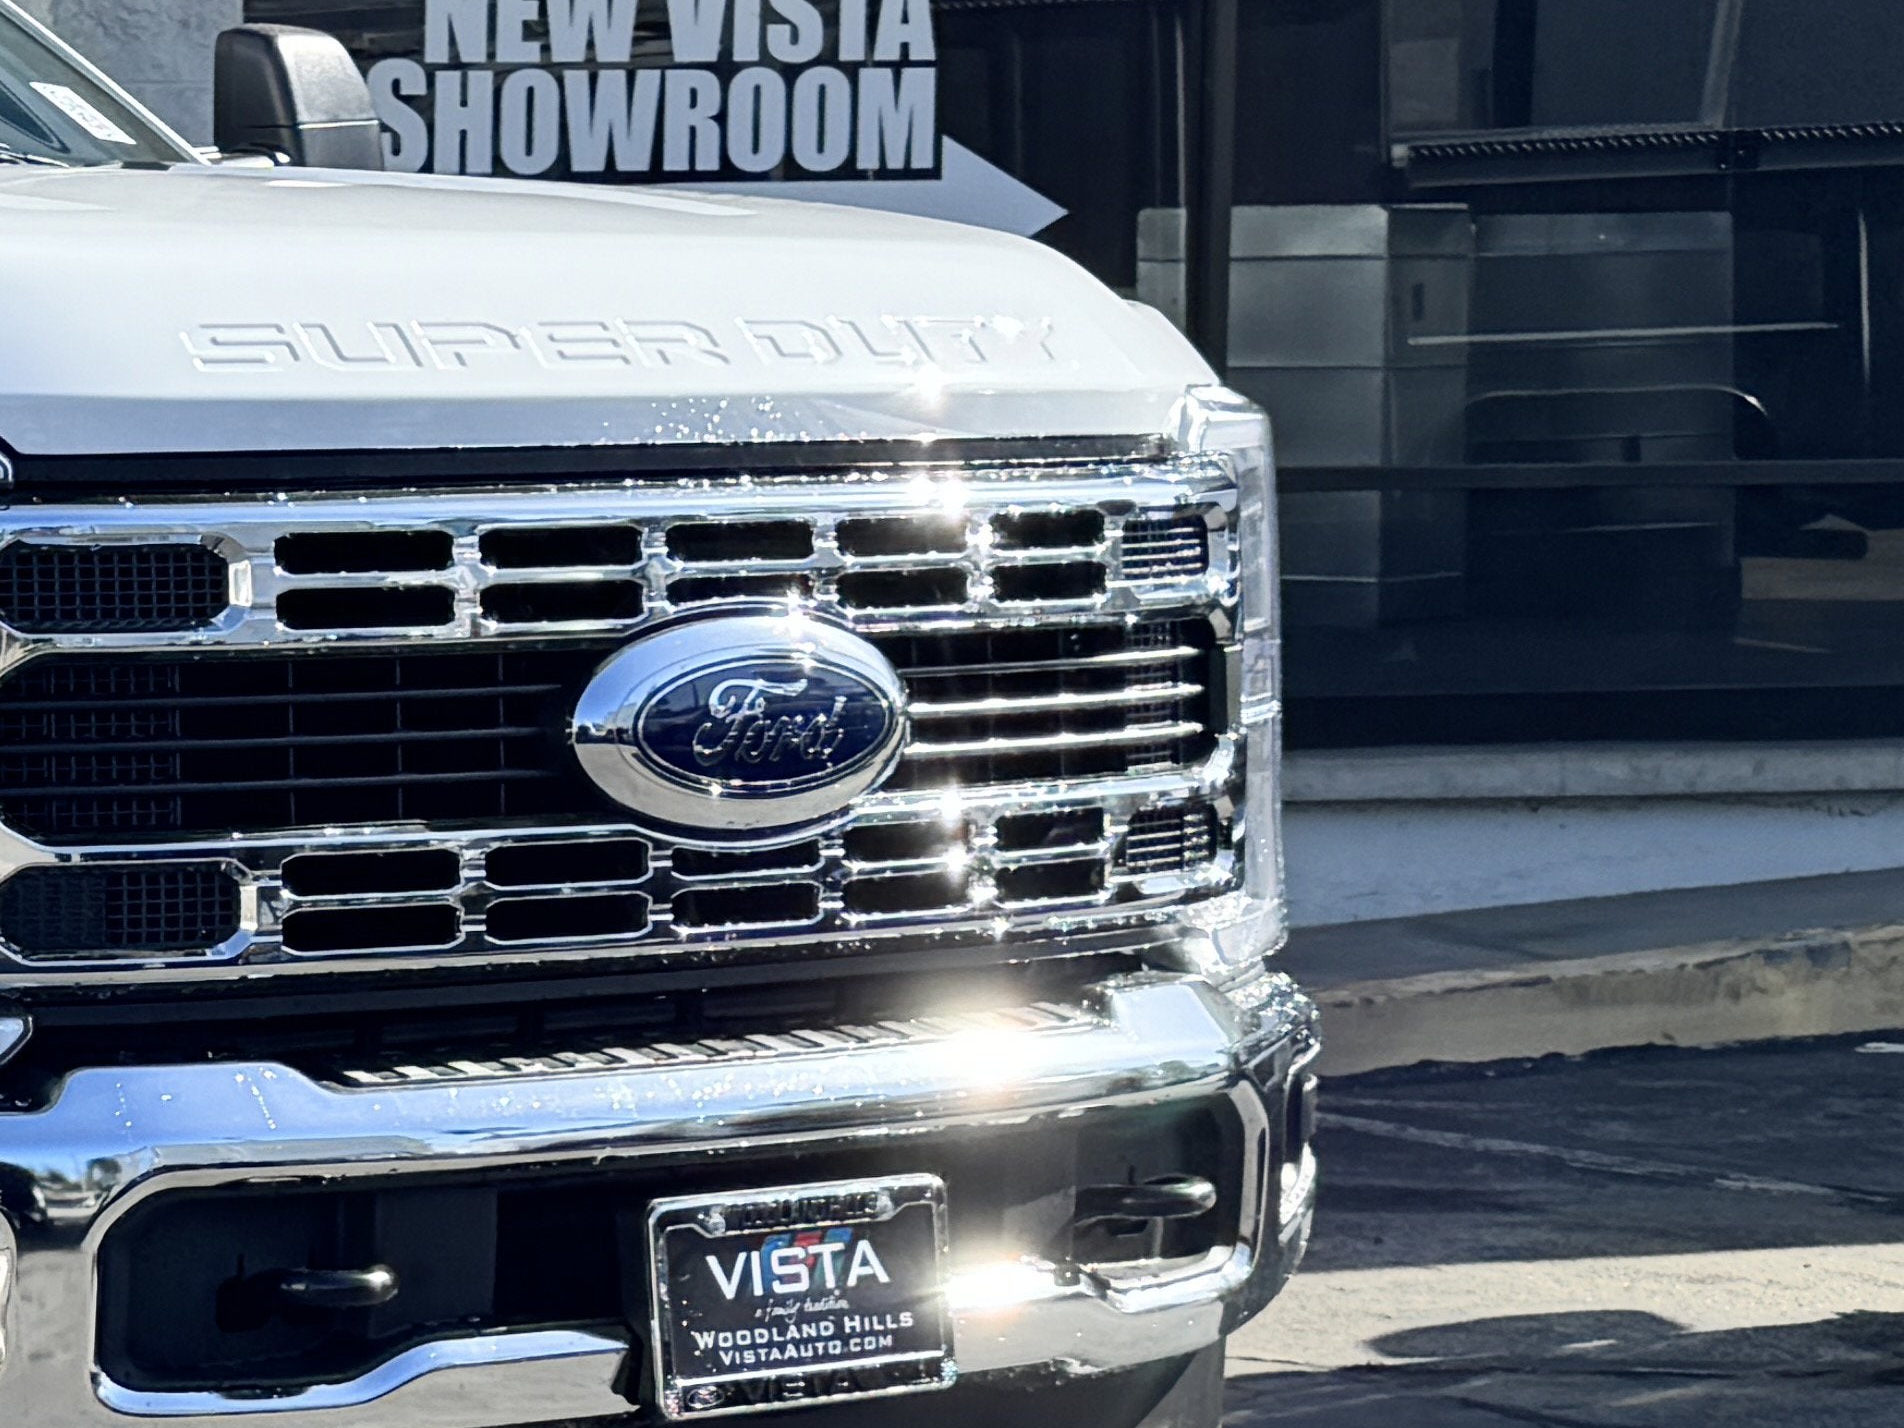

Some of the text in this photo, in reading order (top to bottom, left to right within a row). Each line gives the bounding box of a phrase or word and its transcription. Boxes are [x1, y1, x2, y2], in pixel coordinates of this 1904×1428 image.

[180, 315, 1060, 374] SUPER DUTY
[692, 678, 848, 768] Ford
[705, 1240, 890, 1300] VISTA
